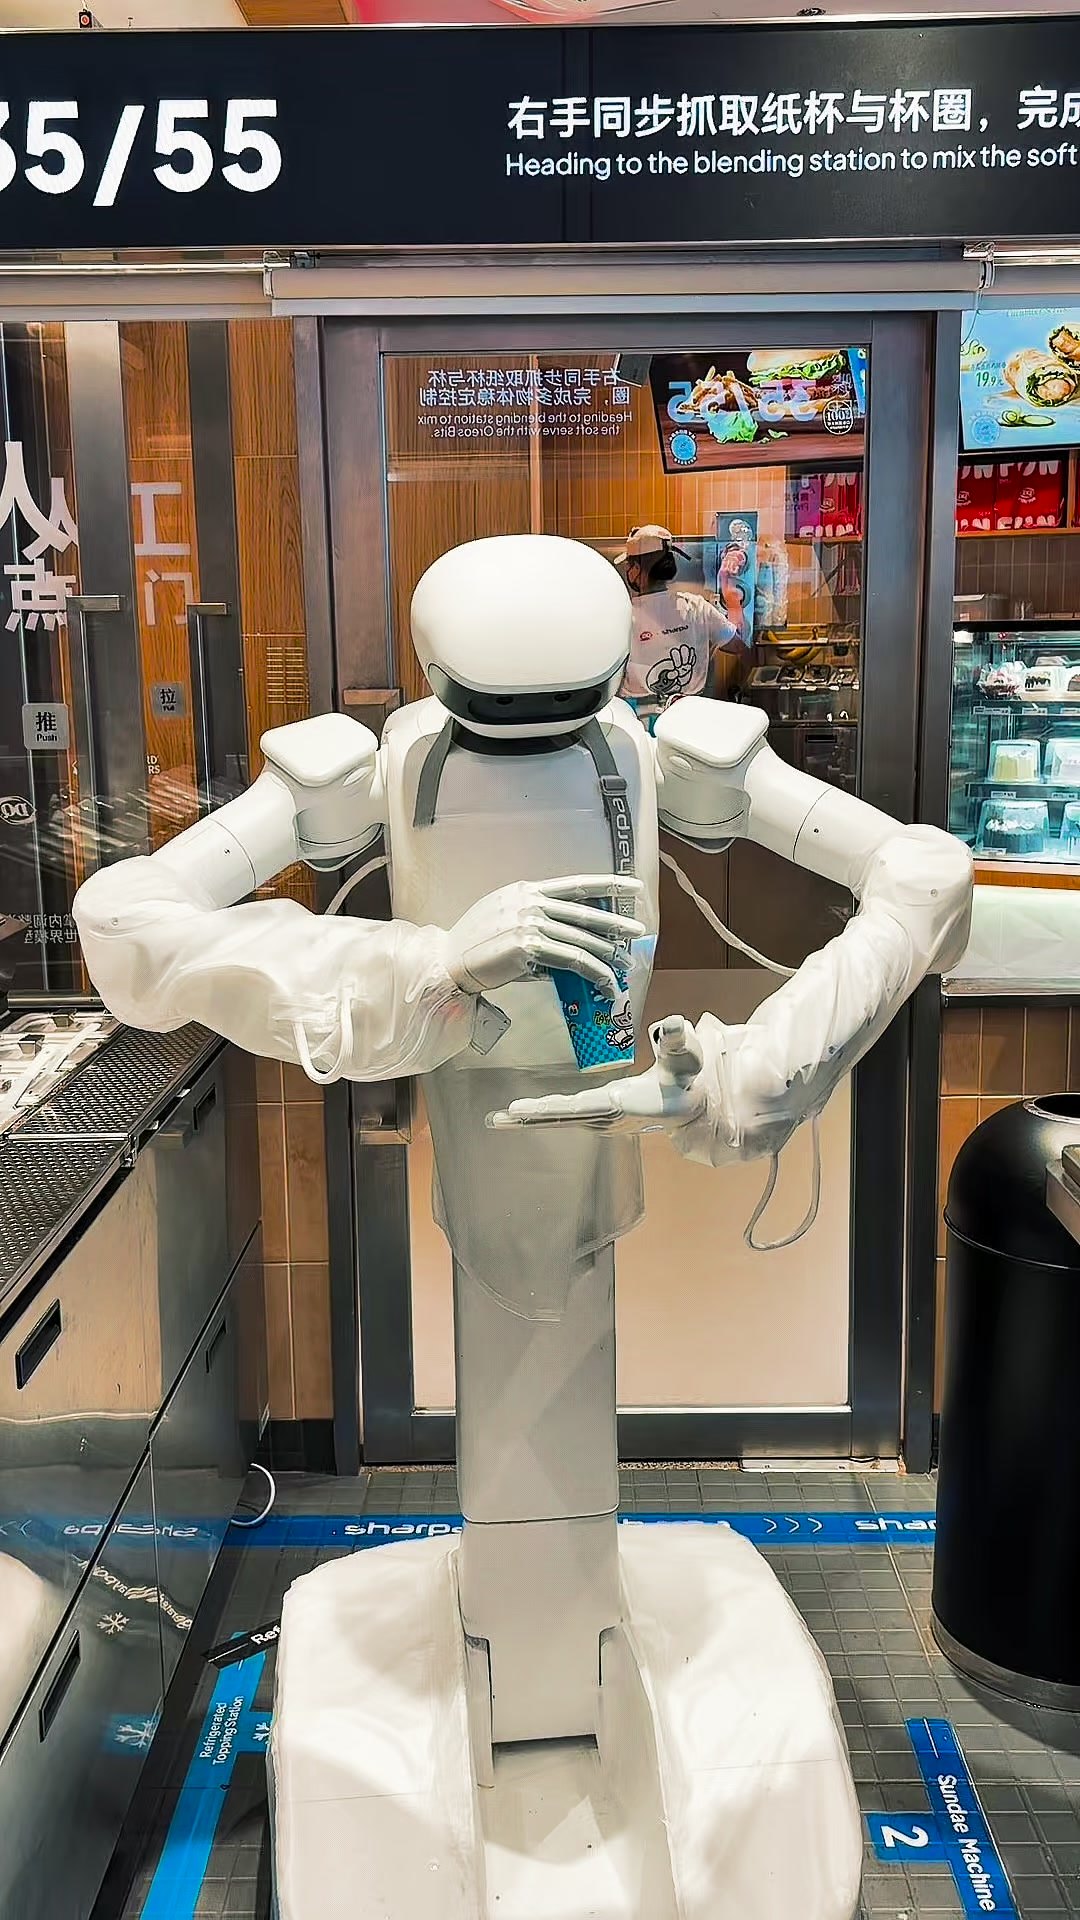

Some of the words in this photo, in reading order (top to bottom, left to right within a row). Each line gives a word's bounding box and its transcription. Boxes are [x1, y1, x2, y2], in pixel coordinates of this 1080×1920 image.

[0, 99, 282, 207] 5/55
[506, 152, 611, 181] Heading
[616, 154, 643, 175] to
[648, 151, 689, 174] the
[694, 149, 804, 178] blending
[809, 147, 896, 172] station
[900, 148, 928, 170] to
[932, 144, 976, 169] mix
[980, 143, 1021, 167] the
[1027, 142, 1078, 167] soft
[160, 688, 176, 704] 拉
[36, 711, 57, 732] 推
[36, 734, 58, 742] Push
[224, 1695, 245, 1728] Station
[199, 1702, 228, 1758] Refrigerated
[212, 1728, 238, 1766] Topping
[880, 1824, 929, 1848] 2
[937, 1774, 970, 1834] Sundae
[958, 1837, 997, 1912] Machine
